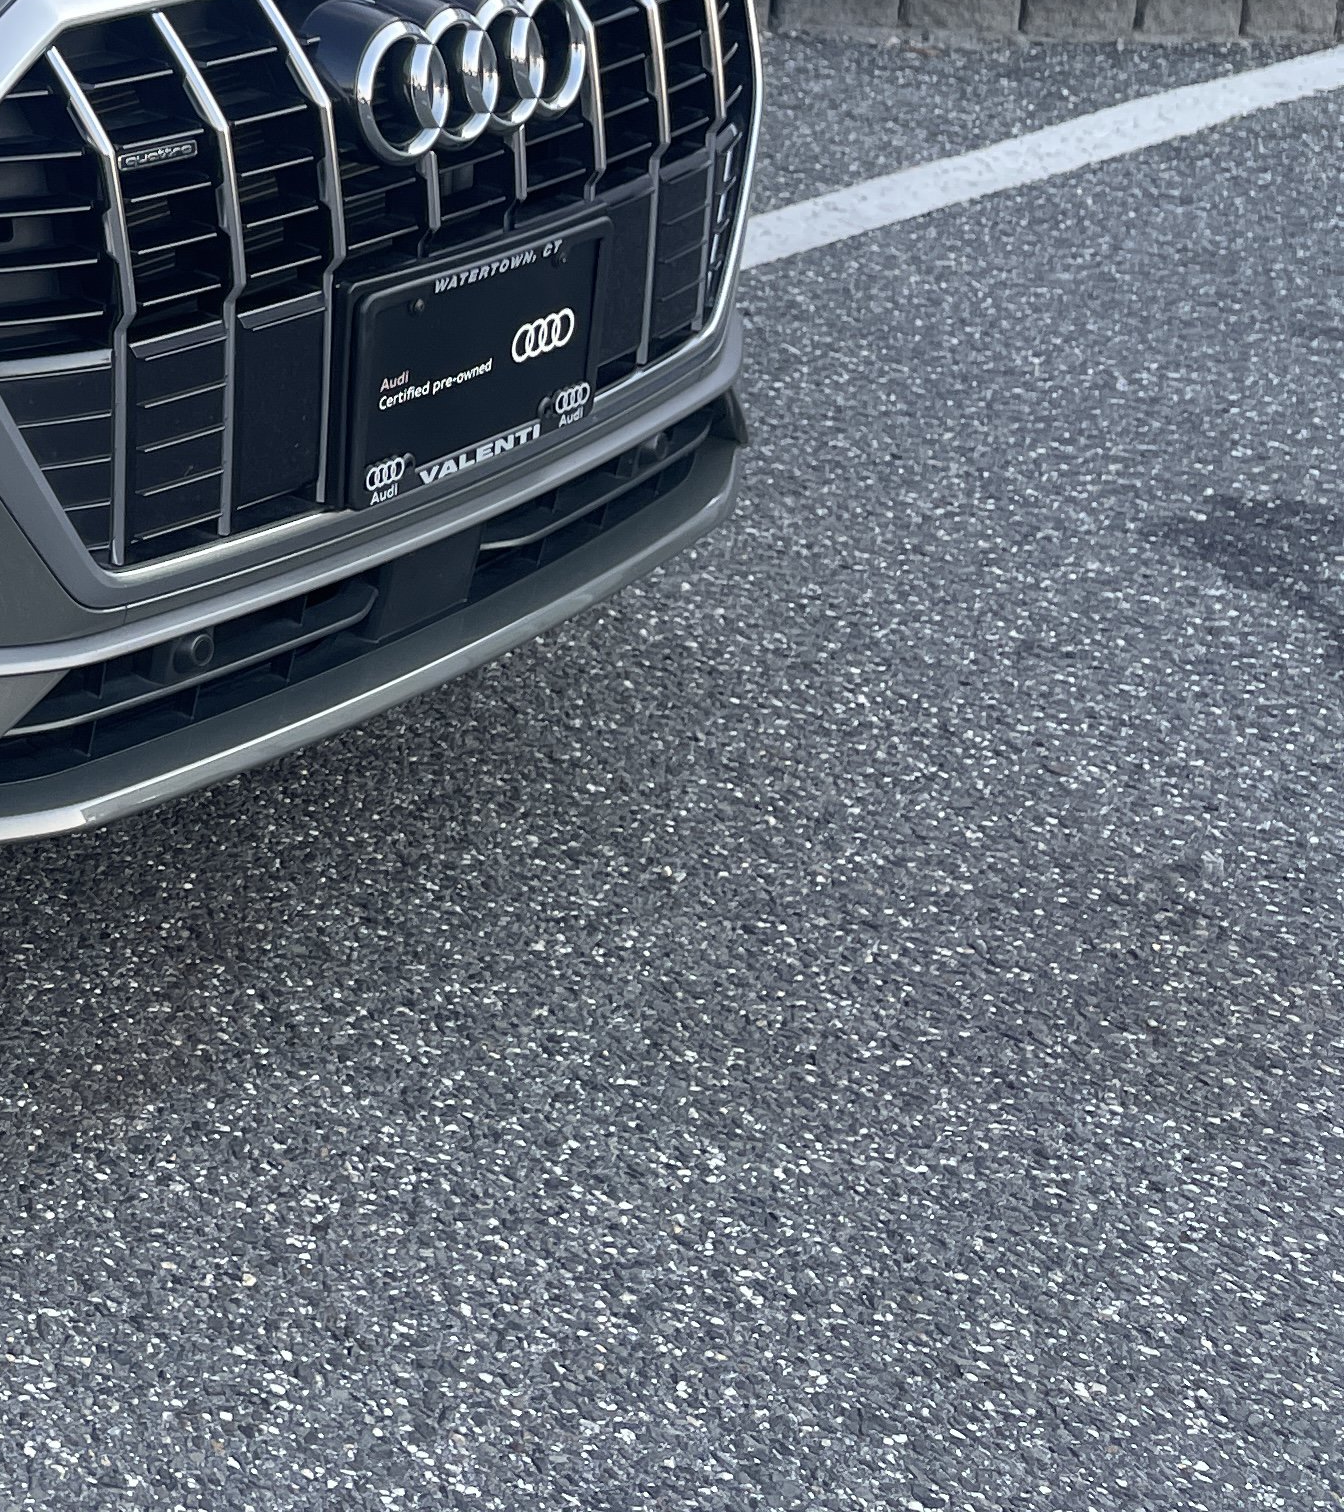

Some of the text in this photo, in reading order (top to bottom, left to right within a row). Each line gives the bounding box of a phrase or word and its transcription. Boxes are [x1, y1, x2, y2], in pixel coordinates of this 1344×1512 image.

[434, 239, 563, 294] WATERTOWN, CT
[379, 358, 493, 410] Certified pre-owned
[380, 370, 410, 392] Audi
[559, 407, 584, 428] Audi
[418, 423, 541, 486] VALENTI
[369, 483, 399, 505] Audi
